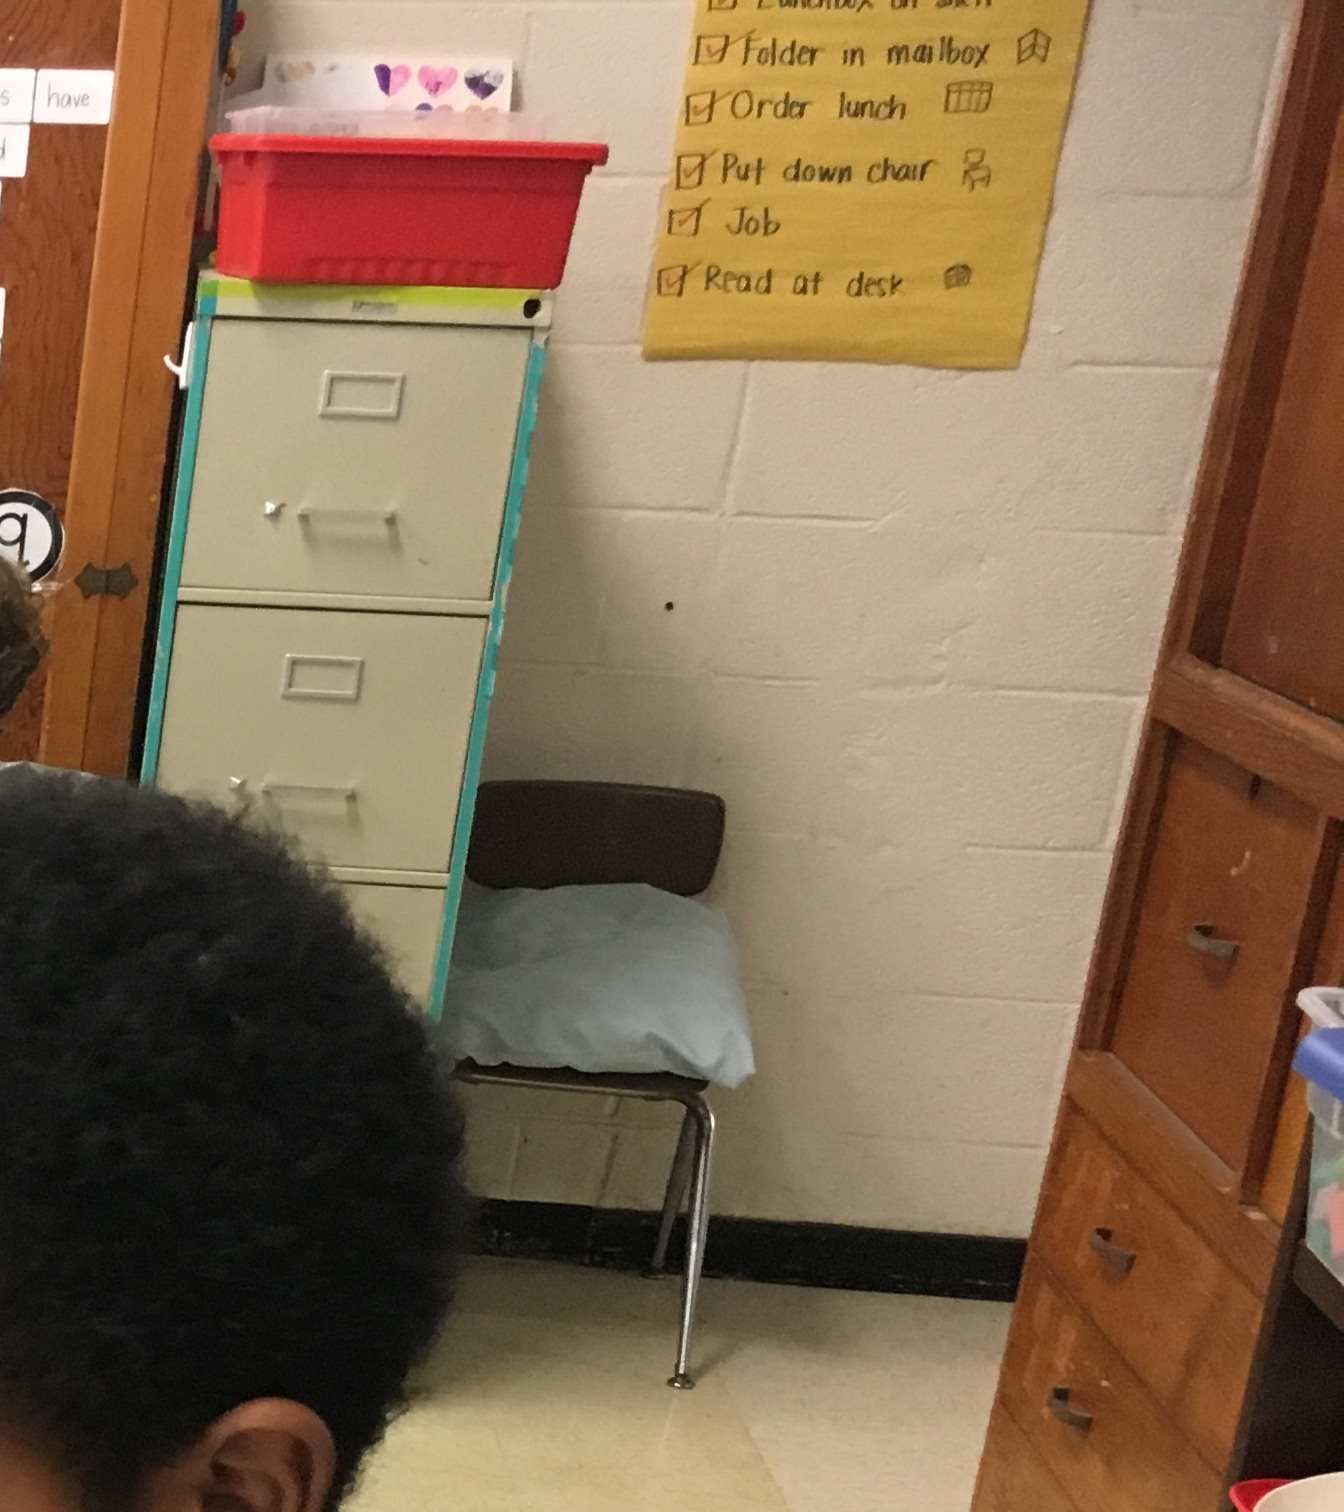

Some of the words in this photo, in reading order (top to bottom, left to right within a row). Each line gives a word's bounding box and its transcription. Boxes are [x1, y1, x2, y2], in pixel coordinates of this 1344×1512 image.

[742, 33, 825, 67] Folder
[843, 47, 865, 67] in
[887, 35, 991, 68] mailbox
[47, 83, 91, 108] have
[730, 89, 811, 120] Order
[838, 91, 908, 121] lunch
[720, 152, 766, 185] Put
[782, 157, 853, 184] down
[866, 156, 938, 184] chair
[725, 205, 782, 237] Job
[703, 263, 773, 296] Read
[792, 270, 824, 296] at
[845, 271, 904, 299] desk
